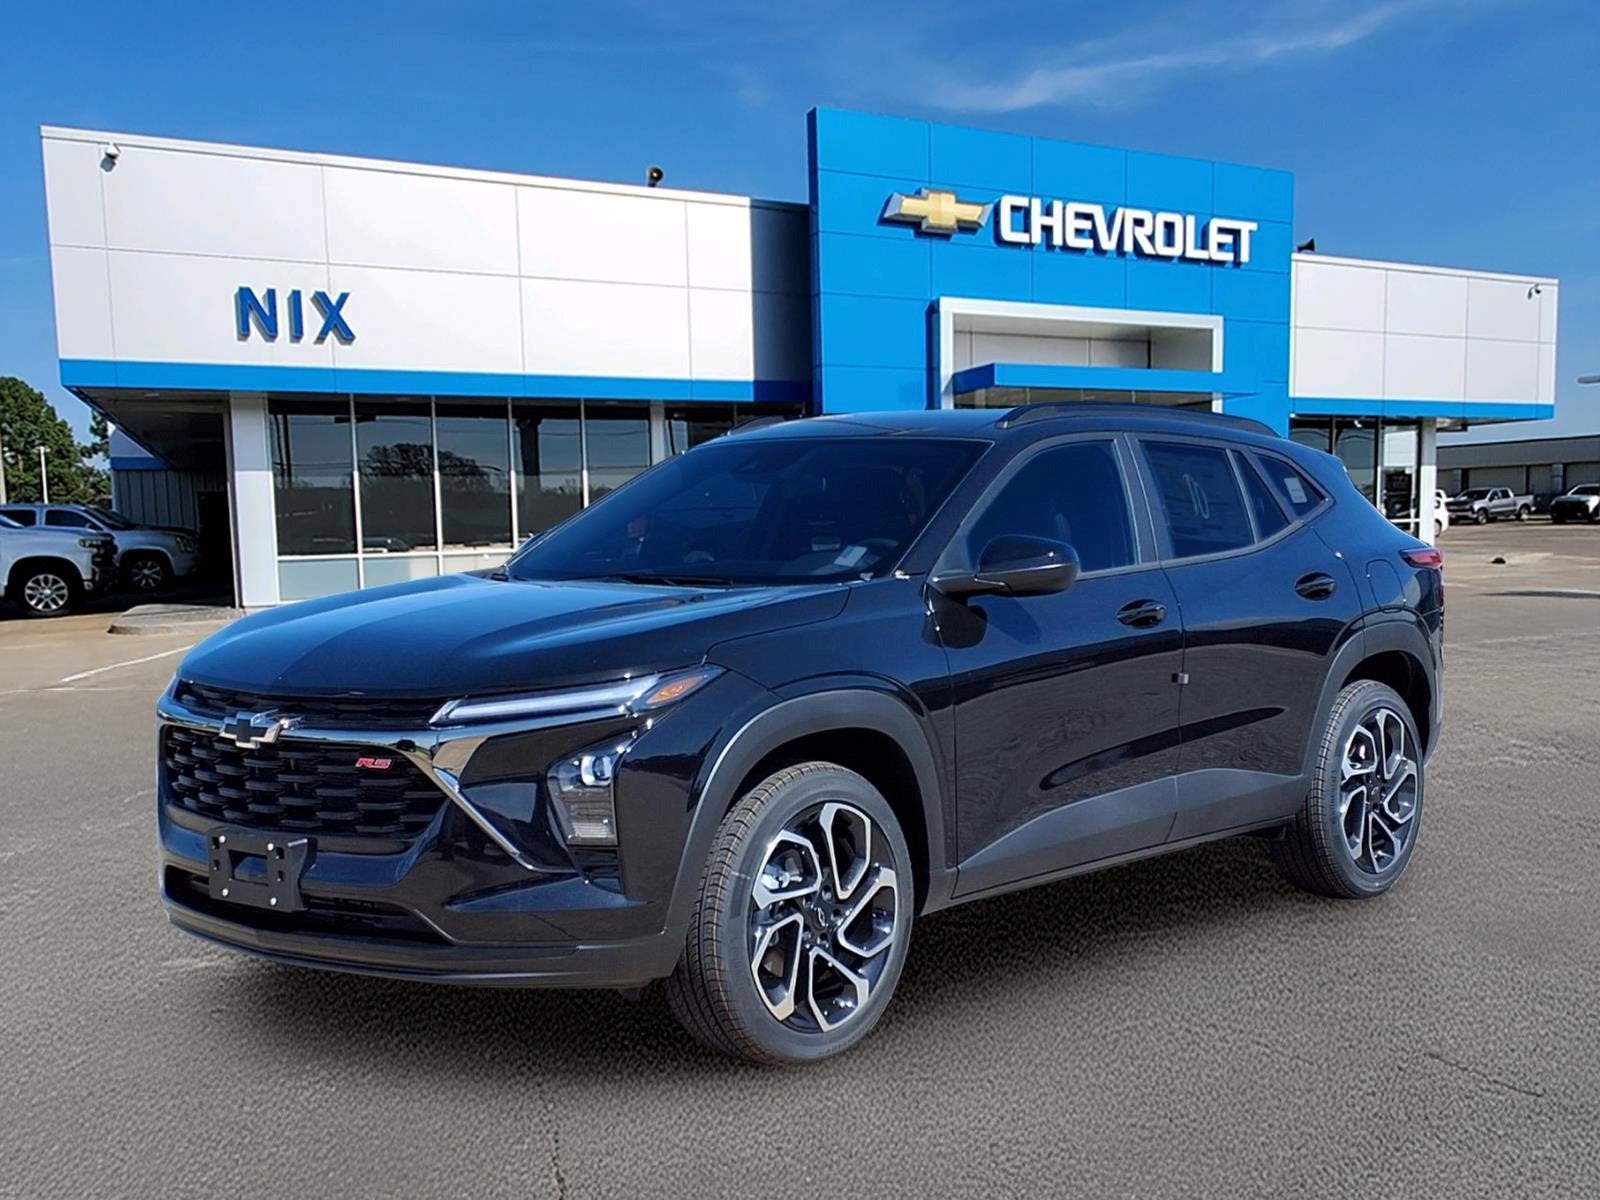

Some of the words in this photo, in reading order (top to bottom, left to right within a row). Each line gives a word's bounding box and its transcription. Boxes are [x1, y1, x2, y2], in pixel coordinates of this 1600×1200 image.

[998, 194, 1258, 264] CHEVROLET
[234, 286, 355, 345] NIX
[355, 757, 391, 769] RS
